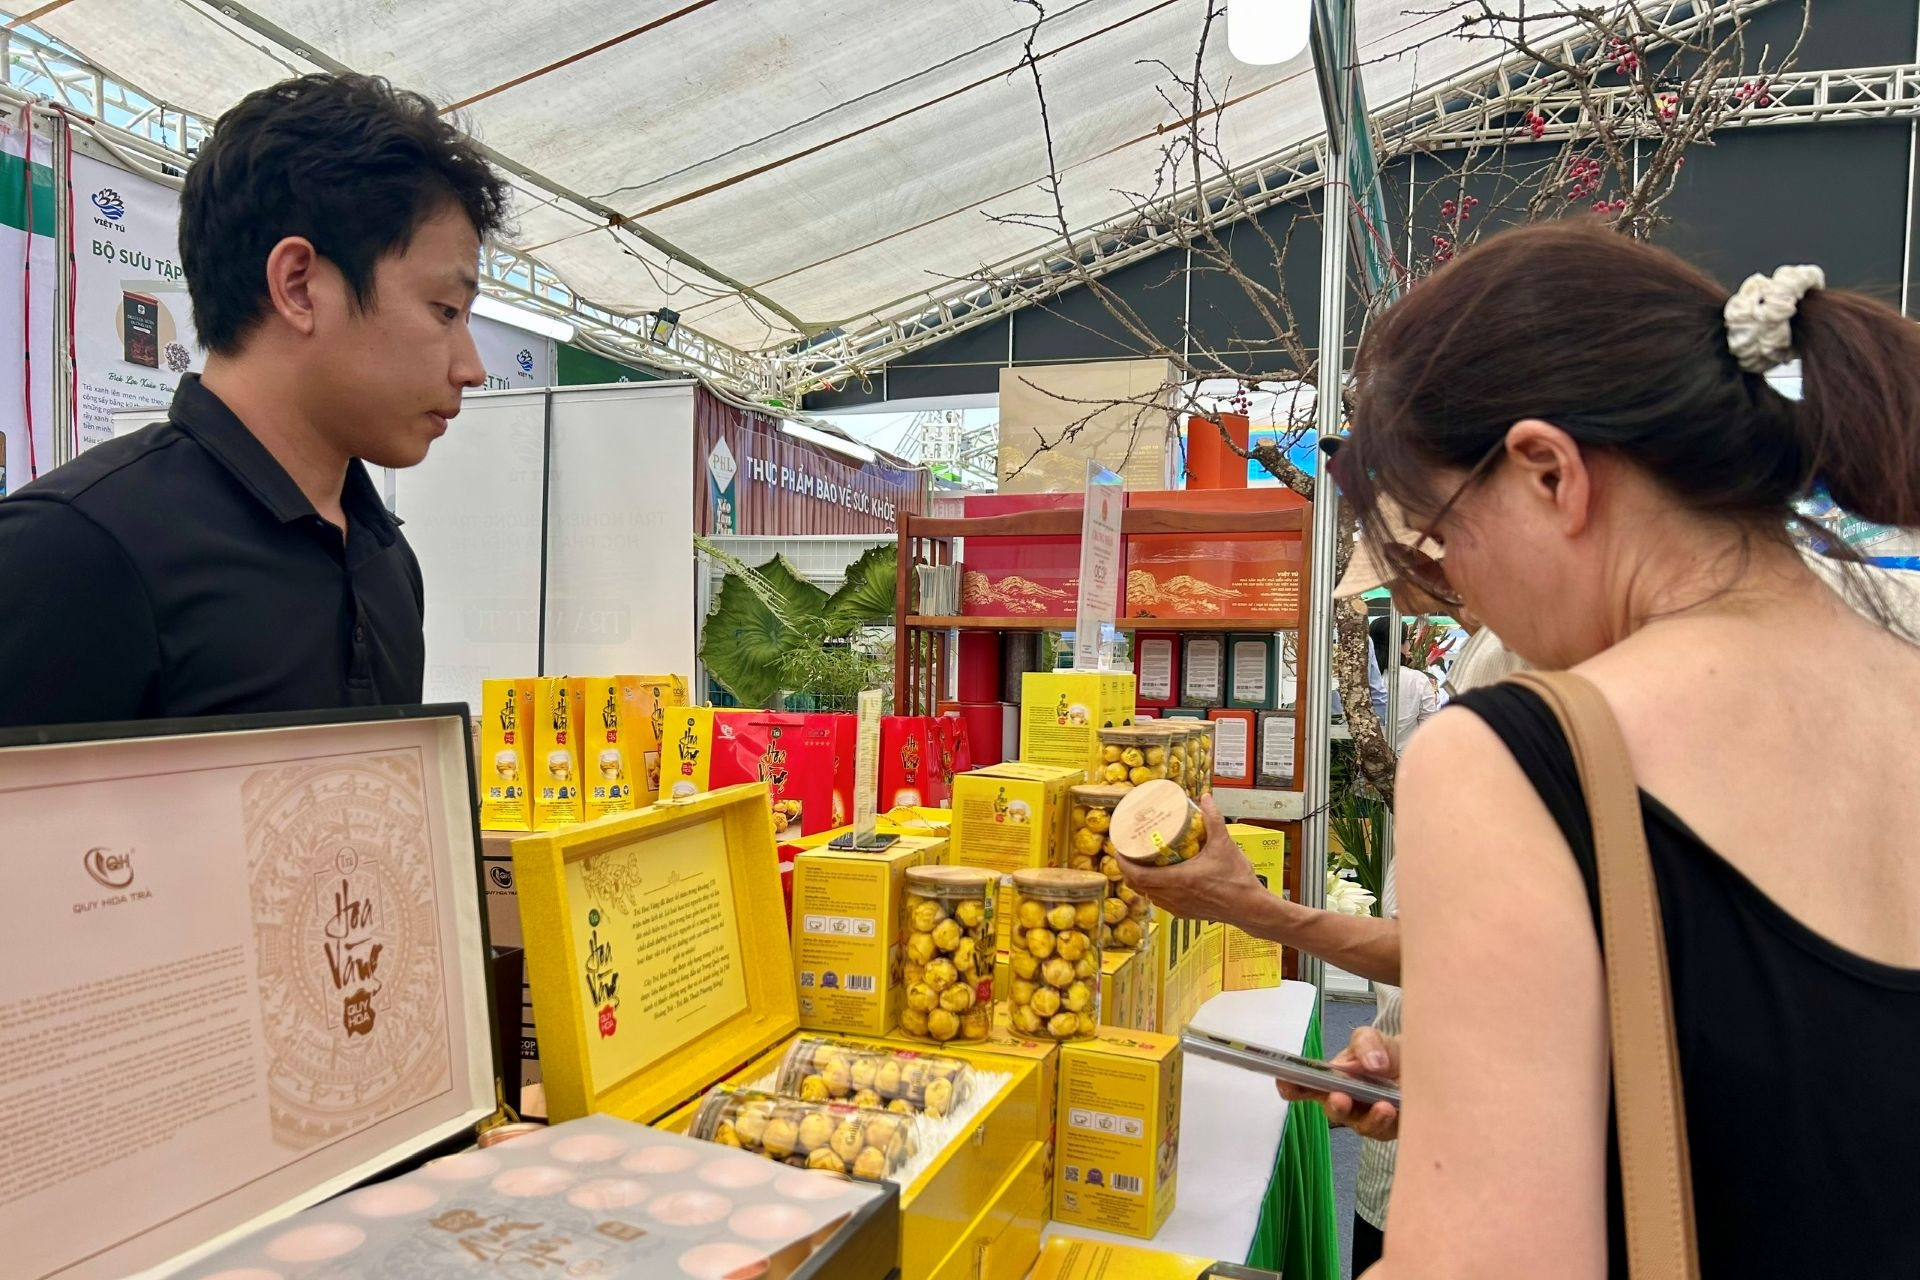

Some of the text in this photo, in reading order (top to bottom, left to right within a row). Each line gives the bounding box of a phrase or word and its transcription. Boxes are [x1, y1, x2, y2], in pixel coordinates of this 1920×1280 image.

[94, 217, 113, 230] VIỆT
[93, 240, 183, 282] BỘ SƯU TẬP
[746, 456, 778, 488] THỰC
[781, 464, 814, 496] PHẨM
[838, 485, 852, 513] VỆ
[853, 489, 869, 514] SỨC
[325, 879, 373, 939] Hoa
[324, 938, 383, 997] Vàng
[586, 930, 612, 973] Hoa
[586, 969, 620, 1011] Vàng
